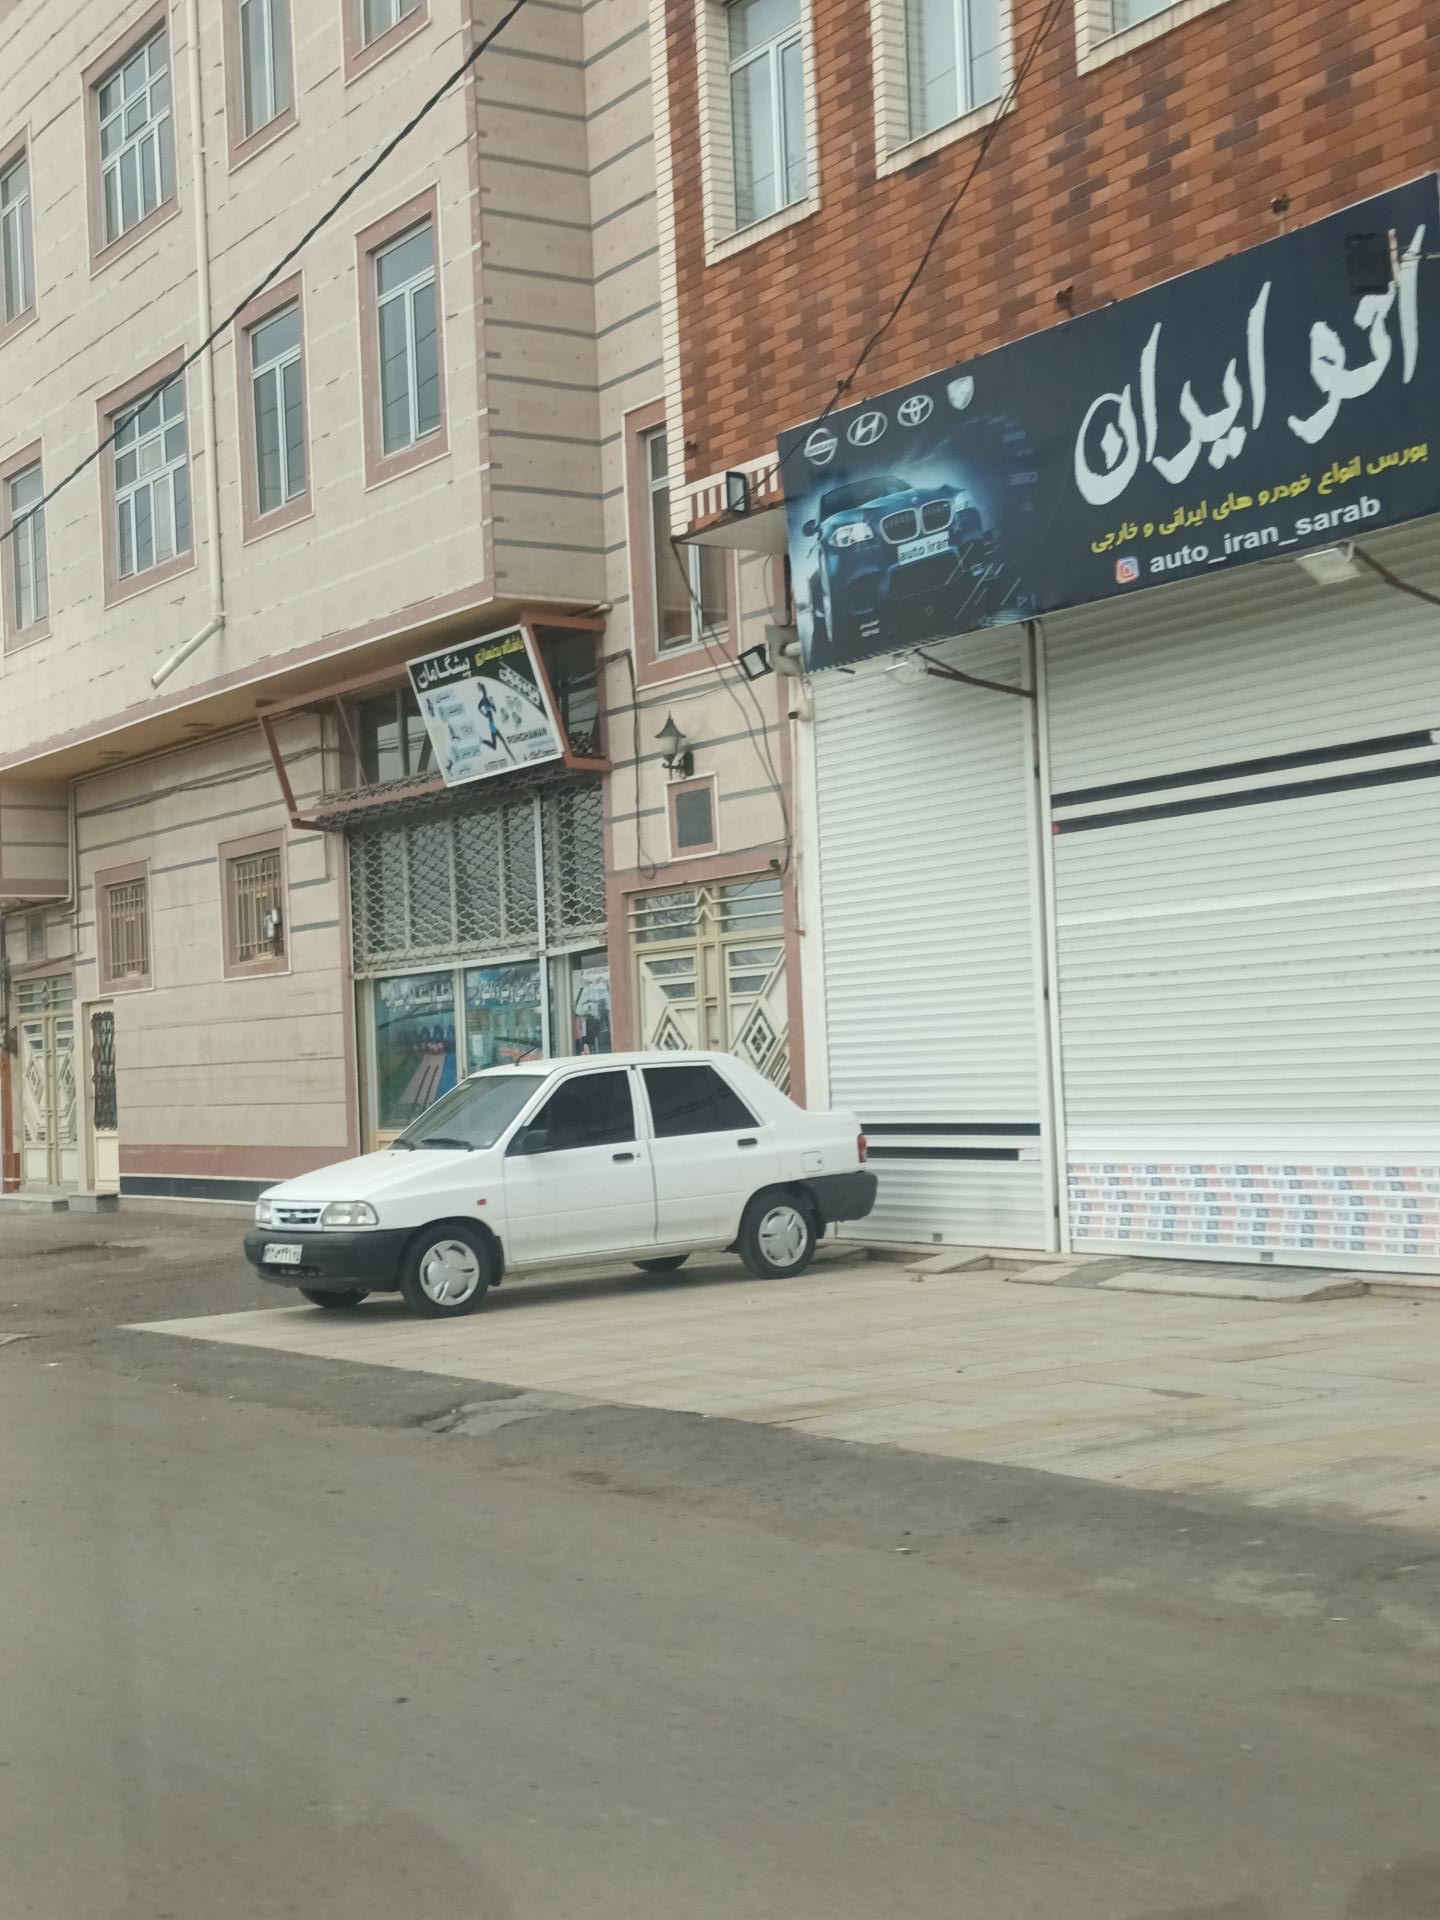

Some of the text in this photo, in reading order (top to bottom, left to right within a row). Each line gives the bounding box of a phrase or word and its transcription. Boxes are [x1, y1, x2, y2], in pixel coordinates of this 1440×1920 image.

[1074, 223, 1426, 506] اتو ایران
[1091, 443, 1428, 553] بورس انواع خودرو های ایرانی و خارجی
[1149, 496, 1381, 573] auto_iran_sarab
[899, 542, 925, 561] auto
